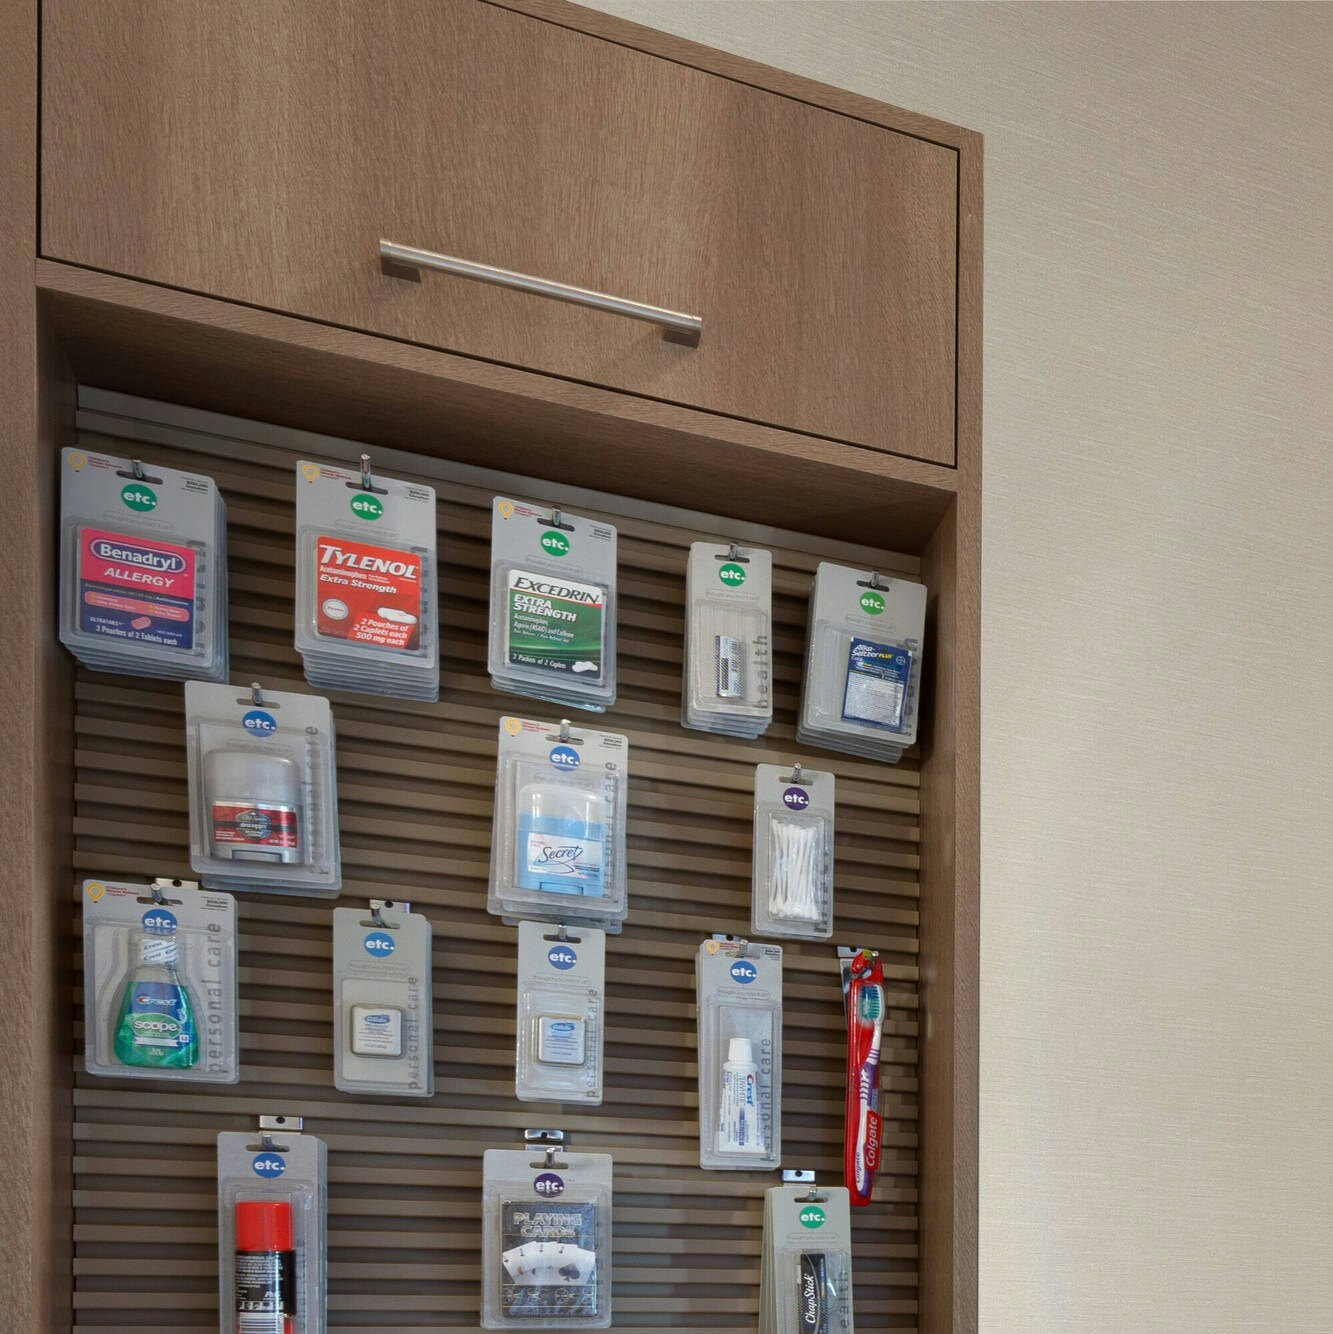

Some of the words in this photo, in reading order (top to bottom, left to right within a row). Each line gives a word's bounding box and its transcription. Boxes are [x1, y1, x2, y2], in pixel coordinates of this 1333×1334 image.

[123, 489, 157, 506] etc.
[352, 501, 383, 515] etc.
[100, 543, 177, 571] Benadryl
[319, 544, 417, 579] TYLENOL
[104, 567, 175, 588] ALLERGY
[720, 568, 746, 582] etc.
[319, 574, 349, 586] Extra
[351, 579, 397, 594] Strength
[514, 577, 600, 603] EXCEDRIN
[513, 594, 552, 608] EXTRA
[513, 603, 577, 622] STRENGTH
[367, 618, 398, 631] Pouches
[141, 632, 162, 644] Tablets
[355, 632, 372, 641] 500
[386, 638, 405, 646] each
[360, 625, 388, 638] Caplets
[389, 631, 408, 639] each
[243, 718, 277, 731] etc.
[550, 753, 579, 766] etc.
[536, 845, 584, 864] Secret
[144, 915, 177, 929] etc.
[207, 922, 222, 969] care
[549, 953, 577, 964] etc.
[134, 1019, 179, 1033] scope
[205, 976, 226, 1073] personal
[866, 1115, 878, 1167] Colgate
[254, 1160, 286, 1171] etc.
[513, 1211, 582, 1226] PLAYING
[801, 1213, 825, 1222] etc.
[804, 1272, 815, 1324] ChapStick
